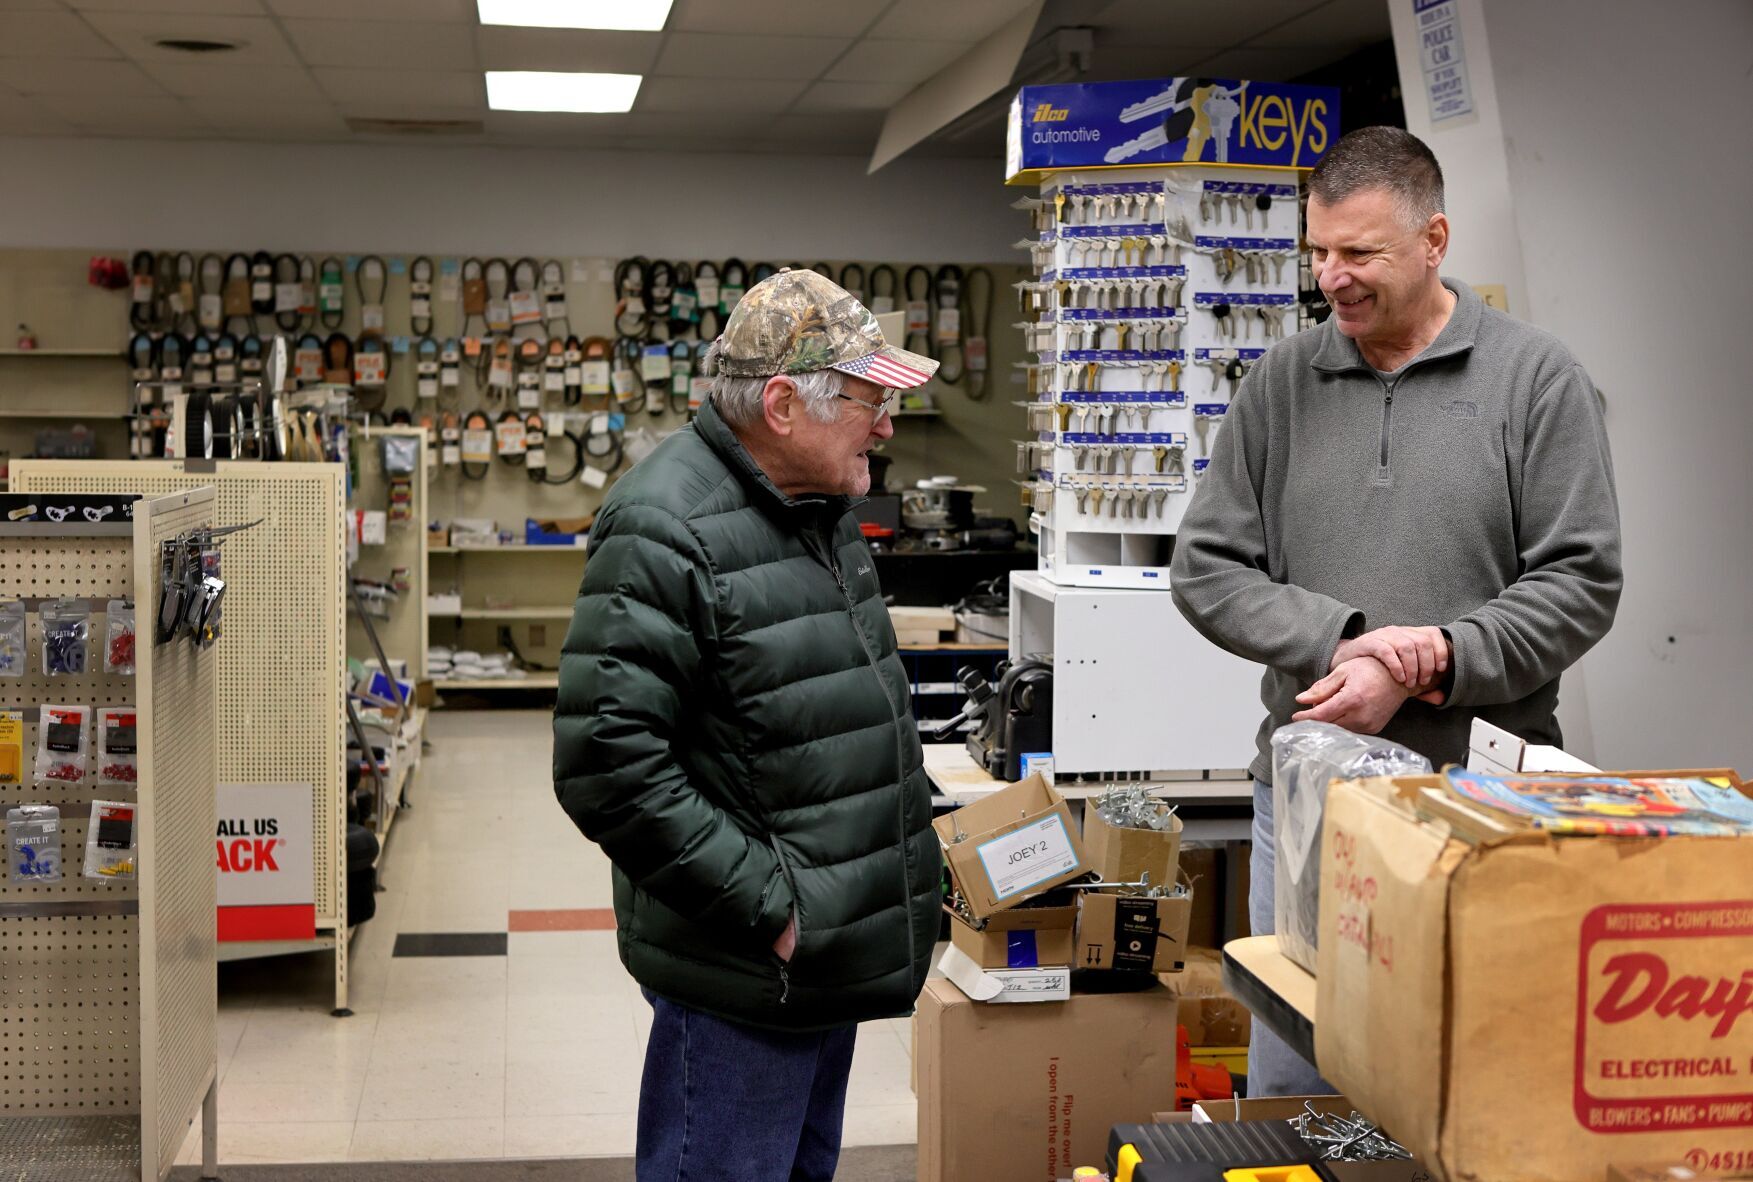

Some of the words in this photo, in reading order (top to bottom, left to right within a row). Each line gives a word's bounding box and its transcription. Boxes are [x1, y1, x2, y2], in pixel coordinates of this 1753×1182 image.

[1422, 24, 1454, 49] POLICE
[1431, 45, 1452, 65] CAR
[1032, 127, 1101, 144] automotive
[1239, 81, 1328, 166] keys
[217, 819, 250, 836] ALL
[254, 818, 278, 836] US
[16, 837, 41, 845] CREATE
[1008, 844, 1037, 865] JOEY
[1039, 840, 1048, 851] 2
[1605, 911, 1662, 932] MOTORS
[1673, 907, 1753, 930] COMPRESSO
[1593, 951, 1753, 1039] Day
[1048, 1064, 1057, 1093] open
[1600, 1057, 1737, 1079] ELECTRICAL
[1048, 1096, 1059, 1122] from
[1061, 1094, 1074, 1116] Flip
[1589, 1108, 1652, 1127] BLOWERS
[1663, 1105, 1697, 1124] FANS
[1708, 1101, 1753, 1122] PUMPS
[1048, 1125, 1058, 1144] the
[1063, 1119, 1072, 1136] me
[1048, 1147, 1058, 1176] other
[1063, 1140, 1073, 1168] over!
